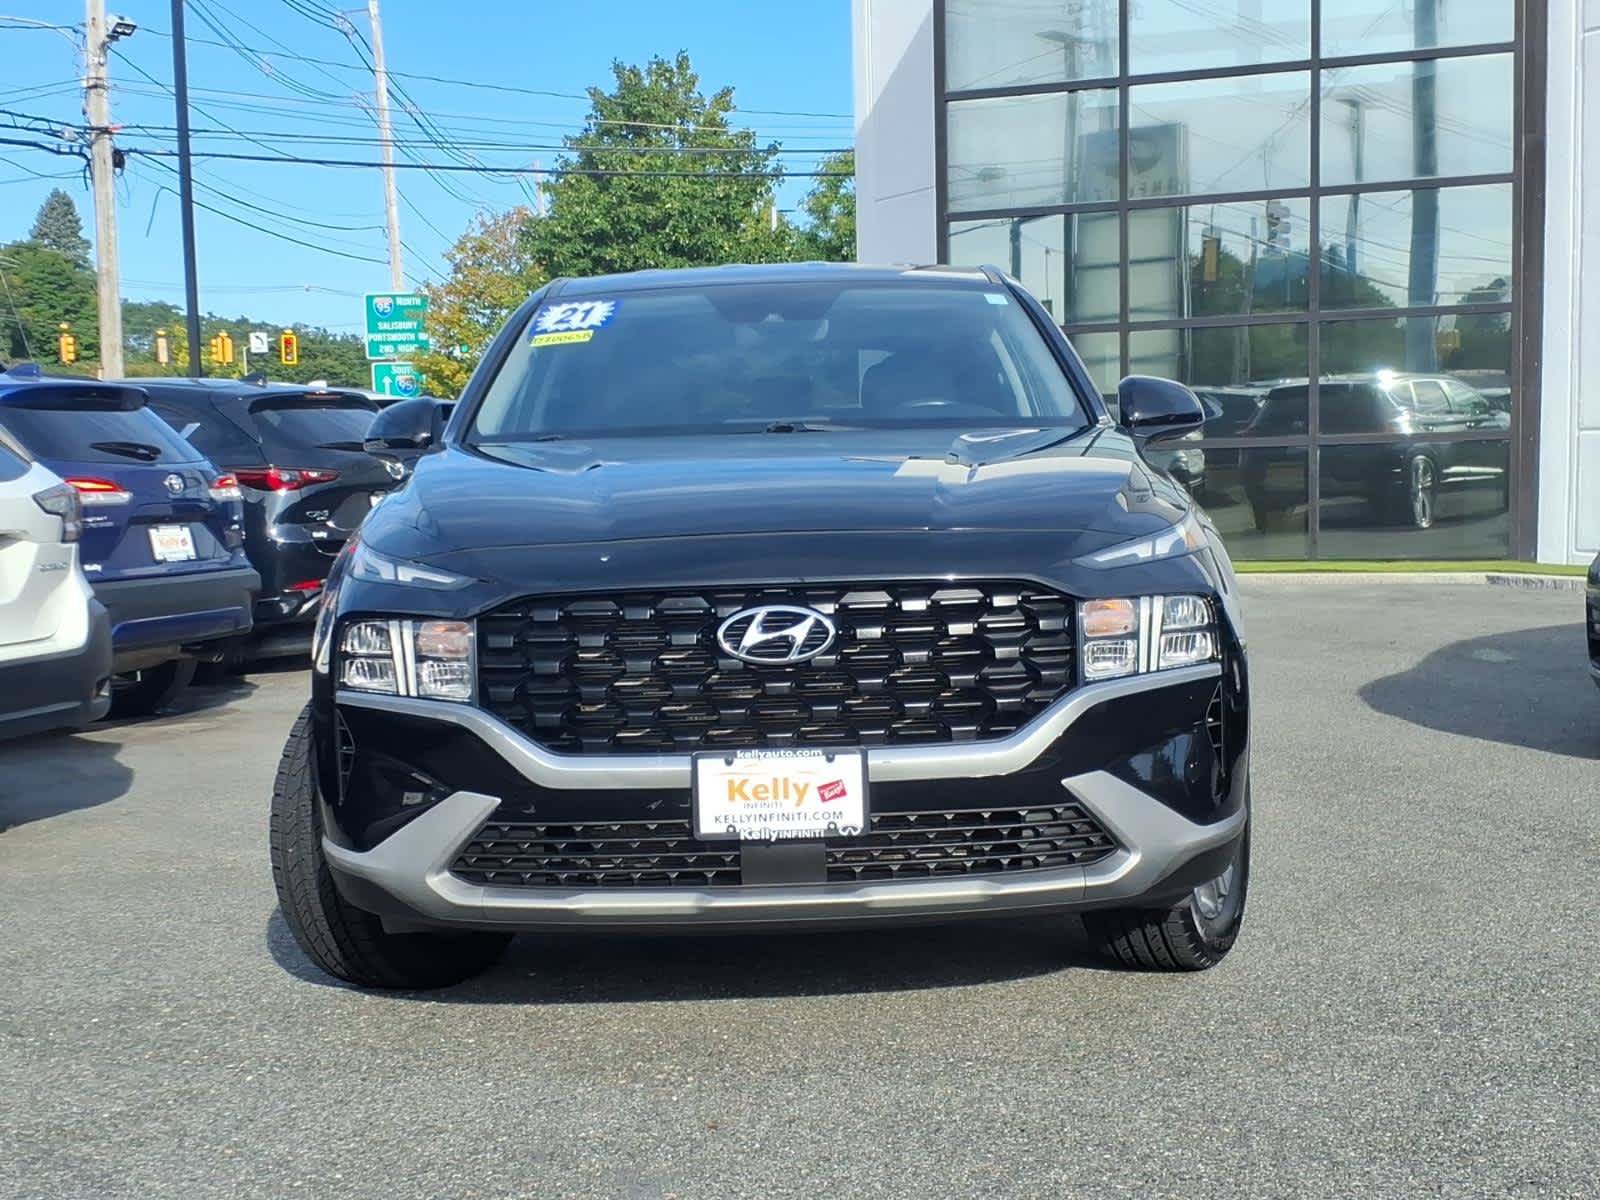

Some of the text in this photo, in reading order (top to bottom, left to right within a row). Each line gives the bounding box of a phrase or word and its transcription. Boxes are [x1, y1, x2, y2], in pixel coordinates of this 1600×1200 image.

[376, 296, 421, 313] 95 NORTH
[553, 306, 596, 325] 21
[378, 320, 417, 330] SALISBURY
[368, 332, 416, 342] PORTSMOUTH
[736, 749, 823, 760] kellyauto.com
[727, 777, 810, 807] Kelly
[743, 799, 784, 809] INFINITI
[714, 810, 844, 824] KELLYINFINITI.COM
